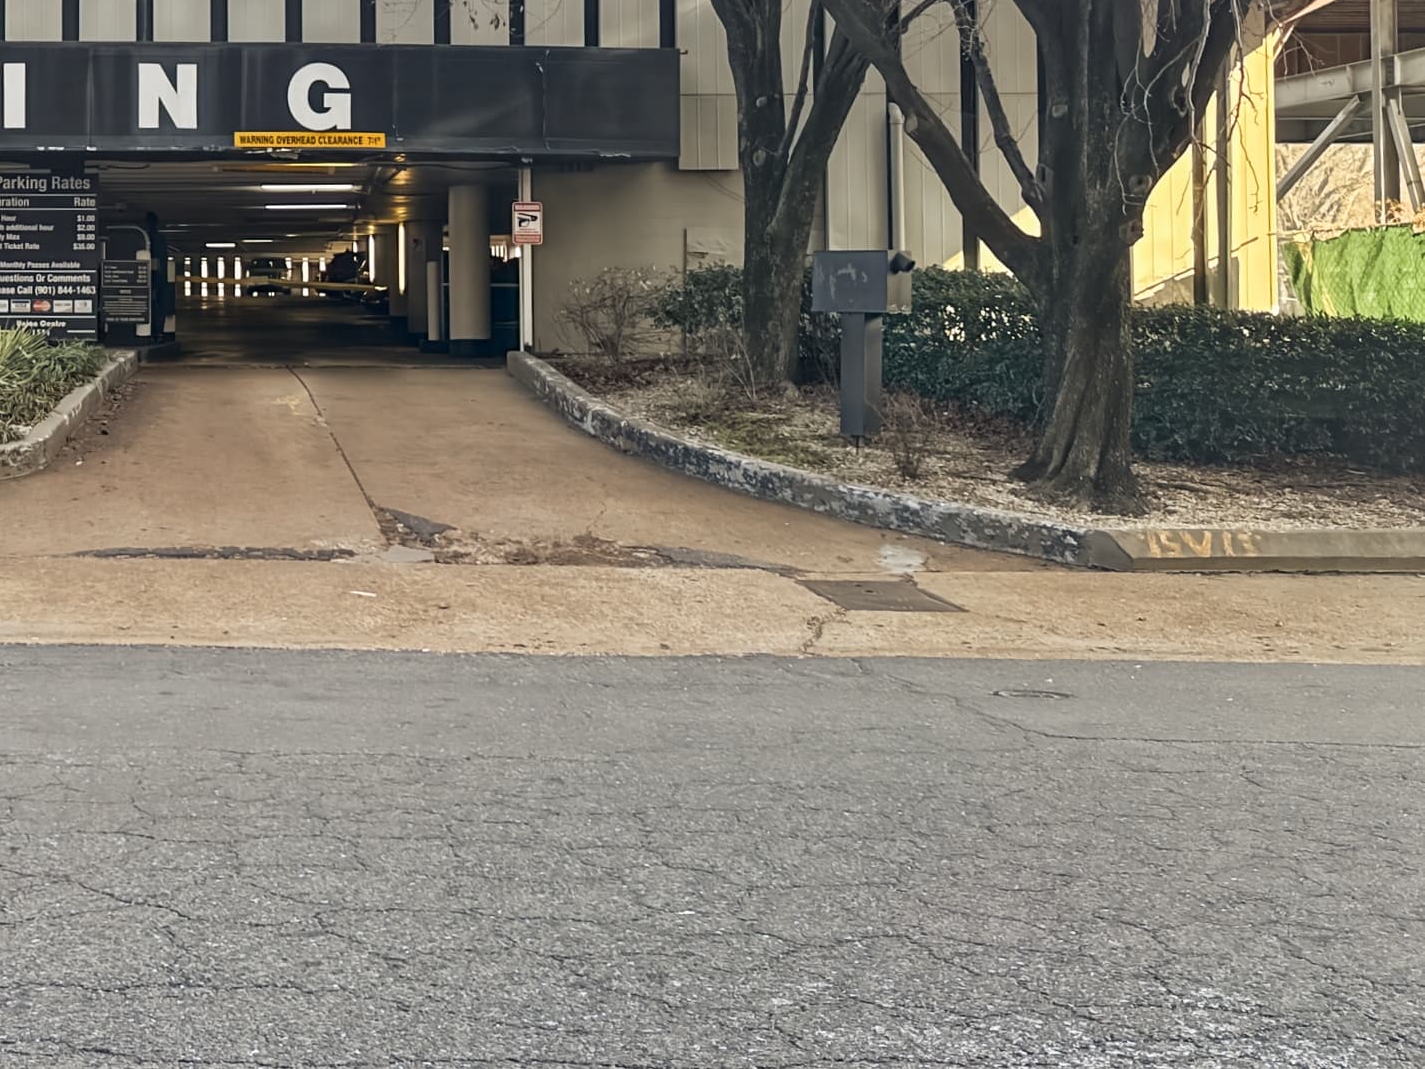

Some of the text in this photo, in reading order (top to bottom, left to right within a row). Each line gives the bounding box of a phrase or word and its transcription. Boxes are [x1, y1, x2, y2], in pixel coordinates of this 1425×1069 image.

[239, 135, 274, 145] WARNING
[276, 135, 316, 145] OVERHEAD
[318, 136, 363, 145] CLEARANCE
[51, 175, 91, 190] Rates
[74, 196, 96, 207] Rate
[1, 214, 17, 222] Hour
[77, 214, 96, 222] $1.00
[4, 242, 24, 250] Ticket
[25, 242, 40, 250] Rate
[0, 261, 81, 269] Monthly Passes Available
[36, 273, 45, 282] Or
[47, 273, 91, 283] Comments
[17, 285, 33, 294] Call
[35, 285, 56, 296] (901)
